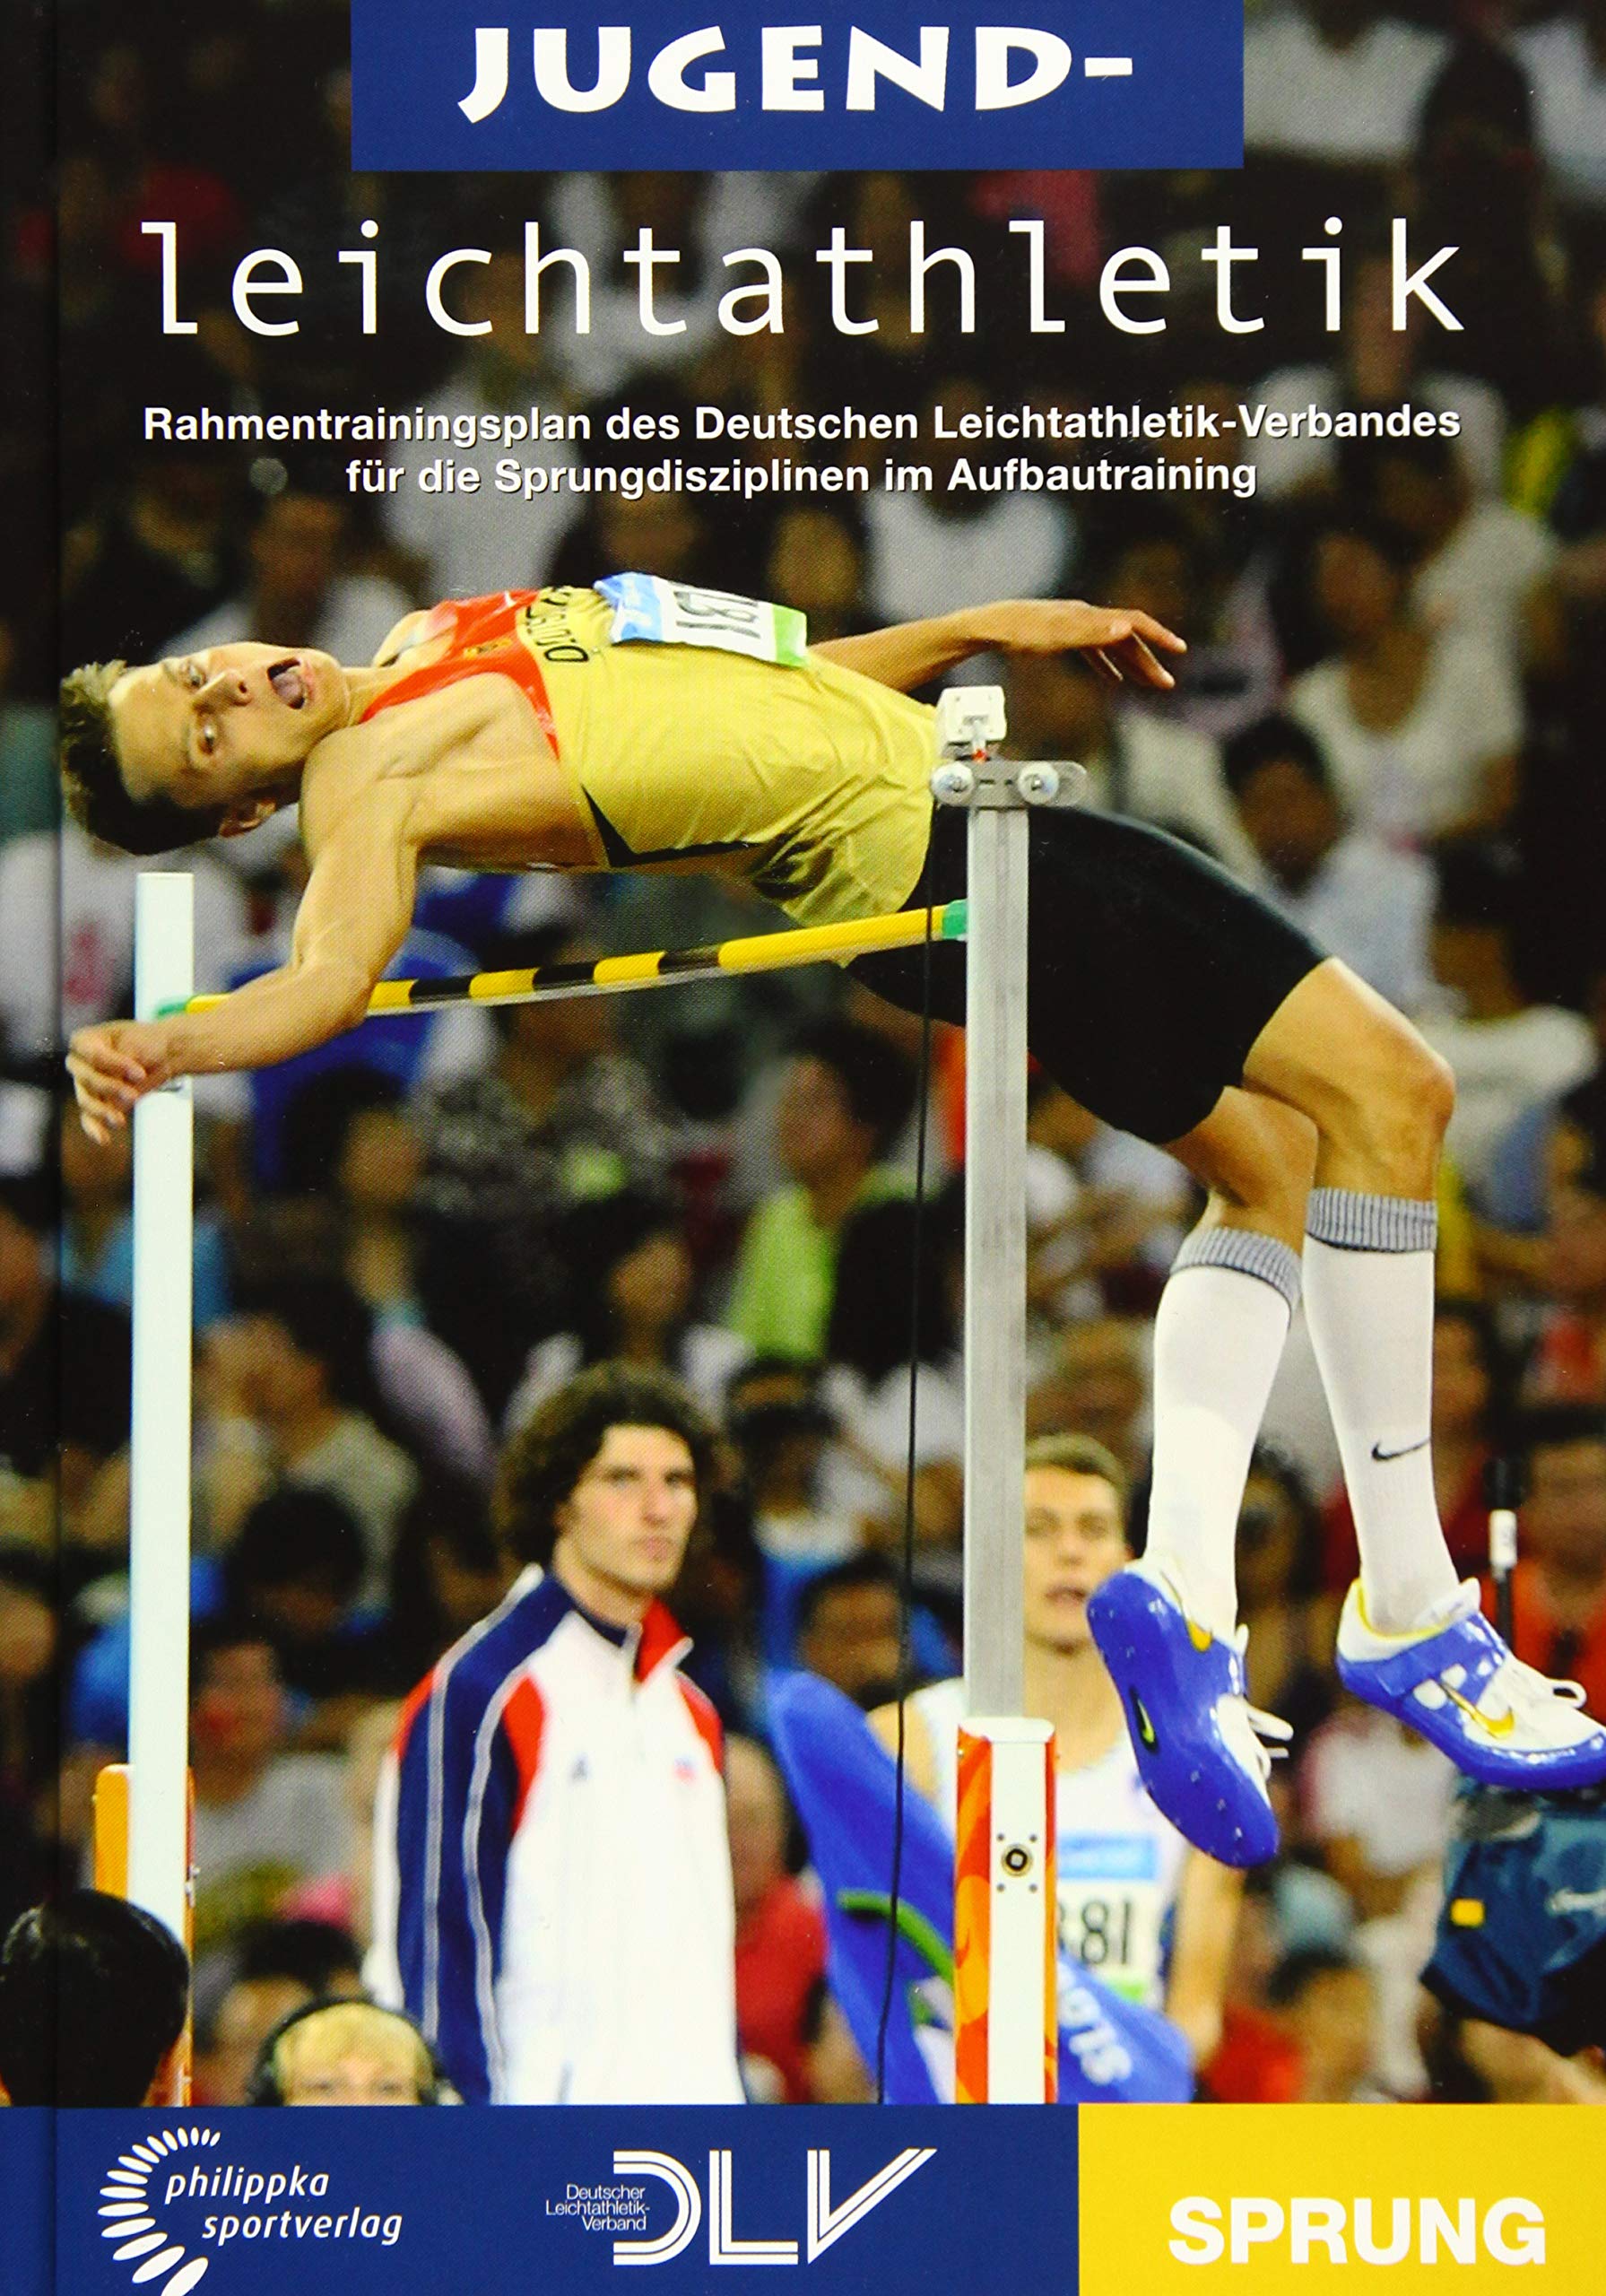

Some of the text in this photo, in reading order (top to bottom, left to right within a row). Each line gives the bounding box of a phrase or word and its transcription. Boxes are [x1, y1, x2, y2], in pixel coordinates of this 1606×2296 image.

[456, 24, 1134, 123] JUGEND-
[141, 217, 1465, 337] leichtathletik
[143, 404, 1461, 448] Rahmentrainingsplan des Deutschen Leichtathletik-Verbandes
[346, 457, 1257, 500] für die Sprungdisziplinen im Aufbautraining
[1060, 1899, 1133, 1967] 81
[163, 2164, 330, 2205] philippka
[565, 2183, 647, 2201] Deutscher
[201, 2205, 404, 2247] sportverlag
[545, 2198, 651, 2216] Leichtathletik-
[582, 2214, 647, 2231] Verband
[612, 2149, 938, 2266] DLV
[1168, 2196, 1547, 2267] SPRUNG
